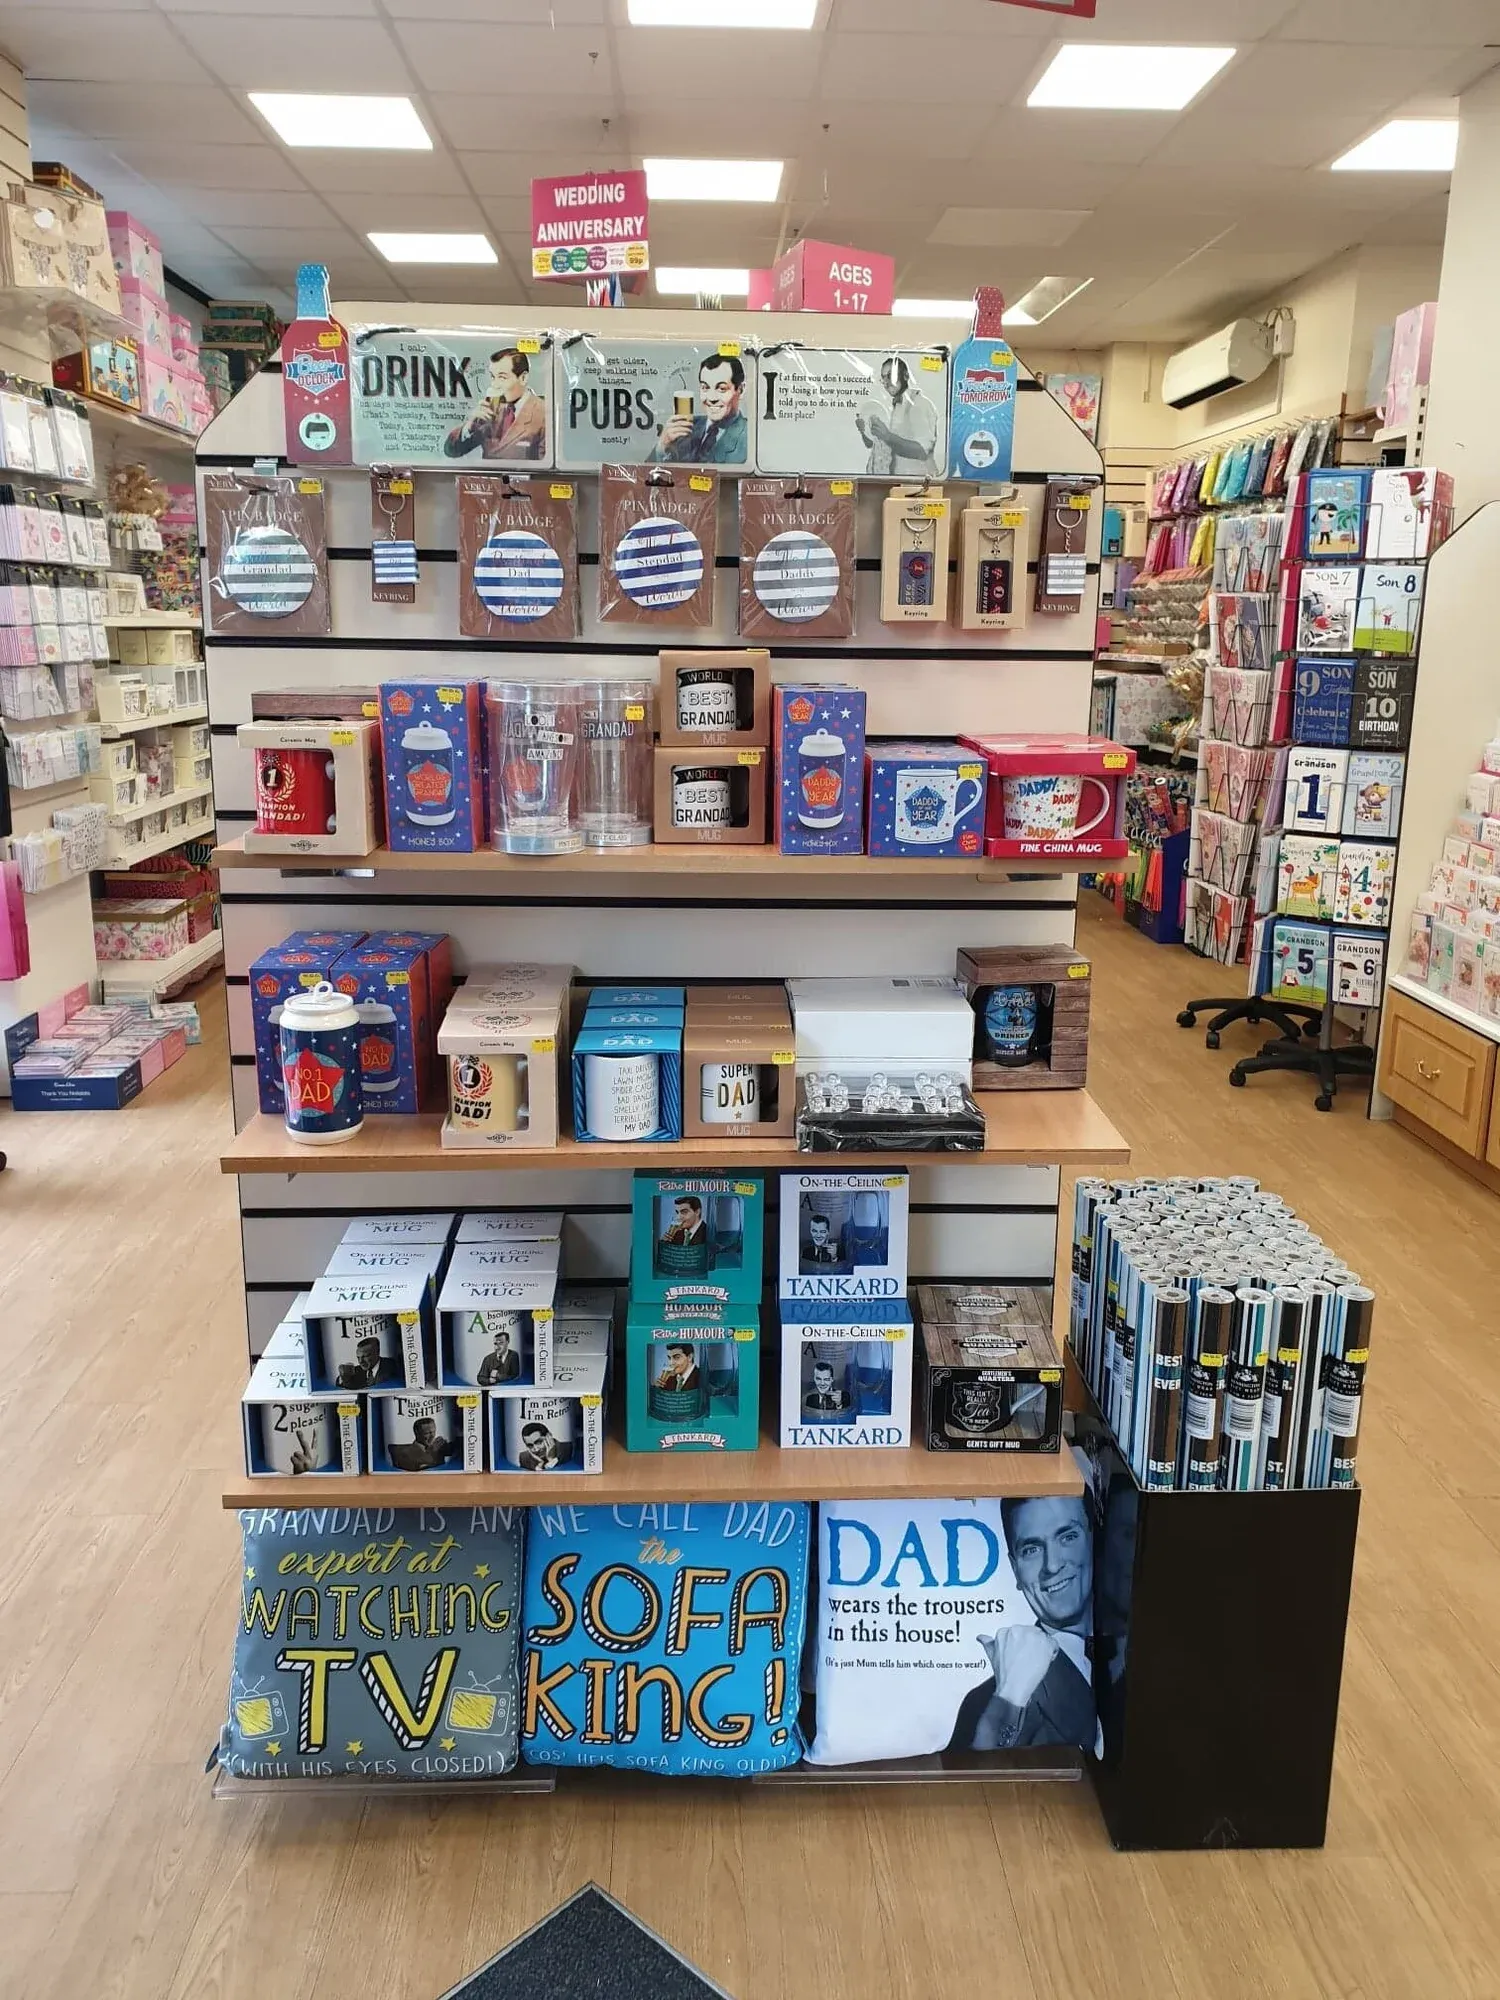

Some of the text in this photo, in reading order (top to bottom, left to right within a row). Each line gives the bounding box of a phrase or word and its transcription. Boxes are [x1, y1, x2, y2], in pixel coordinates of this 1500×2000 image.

[554, 182, 626, 207] WEDDING
[537, 216, 645, 242] ANNIVERSARY
[829, 262, 872, 286] AGES
[833, 289, 868, 312] 1-17
[606, 357, 649, 367] get older,
[362, 354, 472, 399] DRINK
[605, 366, 658, 377] walking into
[792, 373, 841, 382] first don't
[836, 388, 852, 397] your
[960, 391, 1008, 403] TOMORROW
[778, 398, 858, 408] told do the
[569, 387, 664, 437] PUBS,
[778, 410, 793, 419] first
[601, 435, 631, 445] mostly!
[507, 514, 554, 527] BADGE
[763, 513, 835, 526] PIN BADGE
[636, 553, 684, 569] Stepdad
[243, 563, 293, 575] Grandad
[508, 568, 531, 580] Dad
[780, 568, 816, 581] Daddy
[1314, 571, 1351, 585] SON 7
[1375, 574, 1417, 594] Son 8
[373, 592, 409, 601] KEYRING
[1042, 603, 1076, 612] KEYRING
[981, 618, 1005, 626] Keyring
[688, 670, 723, 683] WORLD
[1321, 666, 1353, 679] SON
[1298, 669, 1321, 698] 9
[1367, 671, 1398, 689] SON
[687, 690, 731, 706] BEST
[680, 710, 735, 726] GRANDAD
[582, 720, 634, 739] GRANDAD
[1358, 720, 1400, 732] BIRTHDAY
[702, 733, 727, 745] MUG
[1294, 759, 1337, 770] Grandson
[1389, 760, 1402, 780] 2
[266, 768, 278, 787] 1
[684, 768, 721, 781] WORLD
[807, 777, 837, 788] DADDY
[1018, 776, 1060, 798] DADDY
[685, 787, 727, 803] BEST
[809, 790, 836, 801] YEAR
[912, 797, 939, 807] DADDY
[1052, 793, 1077, 805] DADDY
[1296, 774, 1327, 821] 1
[676, 807, 731, 823] GRANDAD
[912, 810, 938, 821] YEAR
[697, 829, 722, 841] MUG
[1026, 824, 1059, 840] DADDY
[1020, 843, 1103, 853] FINE CHINA MUG
[1312, 849, 1322, 863] 3
[1352, 865, 1373, 893] 4
[1286, 936, 1326, 948] GRANDSON
[1336, 943, 1381, 956] GRANDSON
[1297, 948, 1315, 975] 5
[1363, 958, 1376, 977] 6
[261, 985, 277, 994] DAD
[340, 984, 357, 994] DAD
[610, 1014, 658, 1023] DAD
[602, 1038, 653, 1047] DAD
[361, 1052, 390, 1066] DAD
[296, 1068, 323, 1083] NO.1
[463, 1068, 475, 1086] 1
[720, 1063, 753, 1078] SUPER
[289, 1080, 331, 1103] DAD
[717, 1078, 756, 1108] DAD
[453, 1105, 492, 1121] DAD!
[624, 1119, 651, 1133] MY DAD
[726, 1124, 750, 1136] MUG
[657, 1180, 730, 1193] Retro HUMOUR
[372, 1224, 423, 1233] MUG
[485, 1221, 535, 1230] MUG
[357, 1257, 410, 1266] MUG
[478, 1254, 530, 1264] MUG
[470, 1287, 524, 1297] MUG
[674, 1286, 721, 1297] TANKARD
[786, 1277, 899, 1297] TANKARD
[336, 1290, 392, 1302] MUG
[487, 1322, 507, 1332] Crap
[651, 1327, 726, 1341] Retro HUMOUR
[963, 1388, 992, 1397] THIS ISN'T
[542, 1398, 557, 1408] not
[527, 1409, 544, 1421] I'm
[959, 1402, 990, 1419] Tea
[272, 1404, 288, 1432] 2
[290, 1407, 327, 1433] please!
[669, 1433, 717, 1443] TANKARD
[788, 1426, 904, 1445] TANKARD
[966, 1440, 1021, 1449] GENTS GIFT MUG
[1190, 1459, 1219, 1473] BEST
[238, 1507, 514, 1537] GRANDAD IS AN
[537, 1503, 796, 1548] WE CALL DAD
[636, 1536, 685, 1566] the
[827, 1517, 1000, 1589] DAD
[277, 1535, 463, 1583] expert at
[242, 1580, 511, 1640] WATCHING
[526, 1551, 791, 1657] SOFA
[828, 1593, 1005, 1616] wears the trousers
[828, 1618, 961, 1644] in this house!
[839, 1656, 855, 1670] just
[856, 1658, 878, 1668] Mum
[879, 1657, 895, 1669] tells
[896, 1657, 911, 1669] him
[912, 1658, 934, 1669] which
[935, 1661, 953, 1669] ones
[954, 1660, 963, 1669] to
[964, 1658, 987, 1671] wear!)
[274, 1647, 462, 1756] TV
[520, 1647, 789, 1750] KING!
[302, 1750, 506, 1775] HIS EYES CLOSED!)
[626, 1755, 669, 1768] SOFA
[681, 1755, 726, 1770] KING
